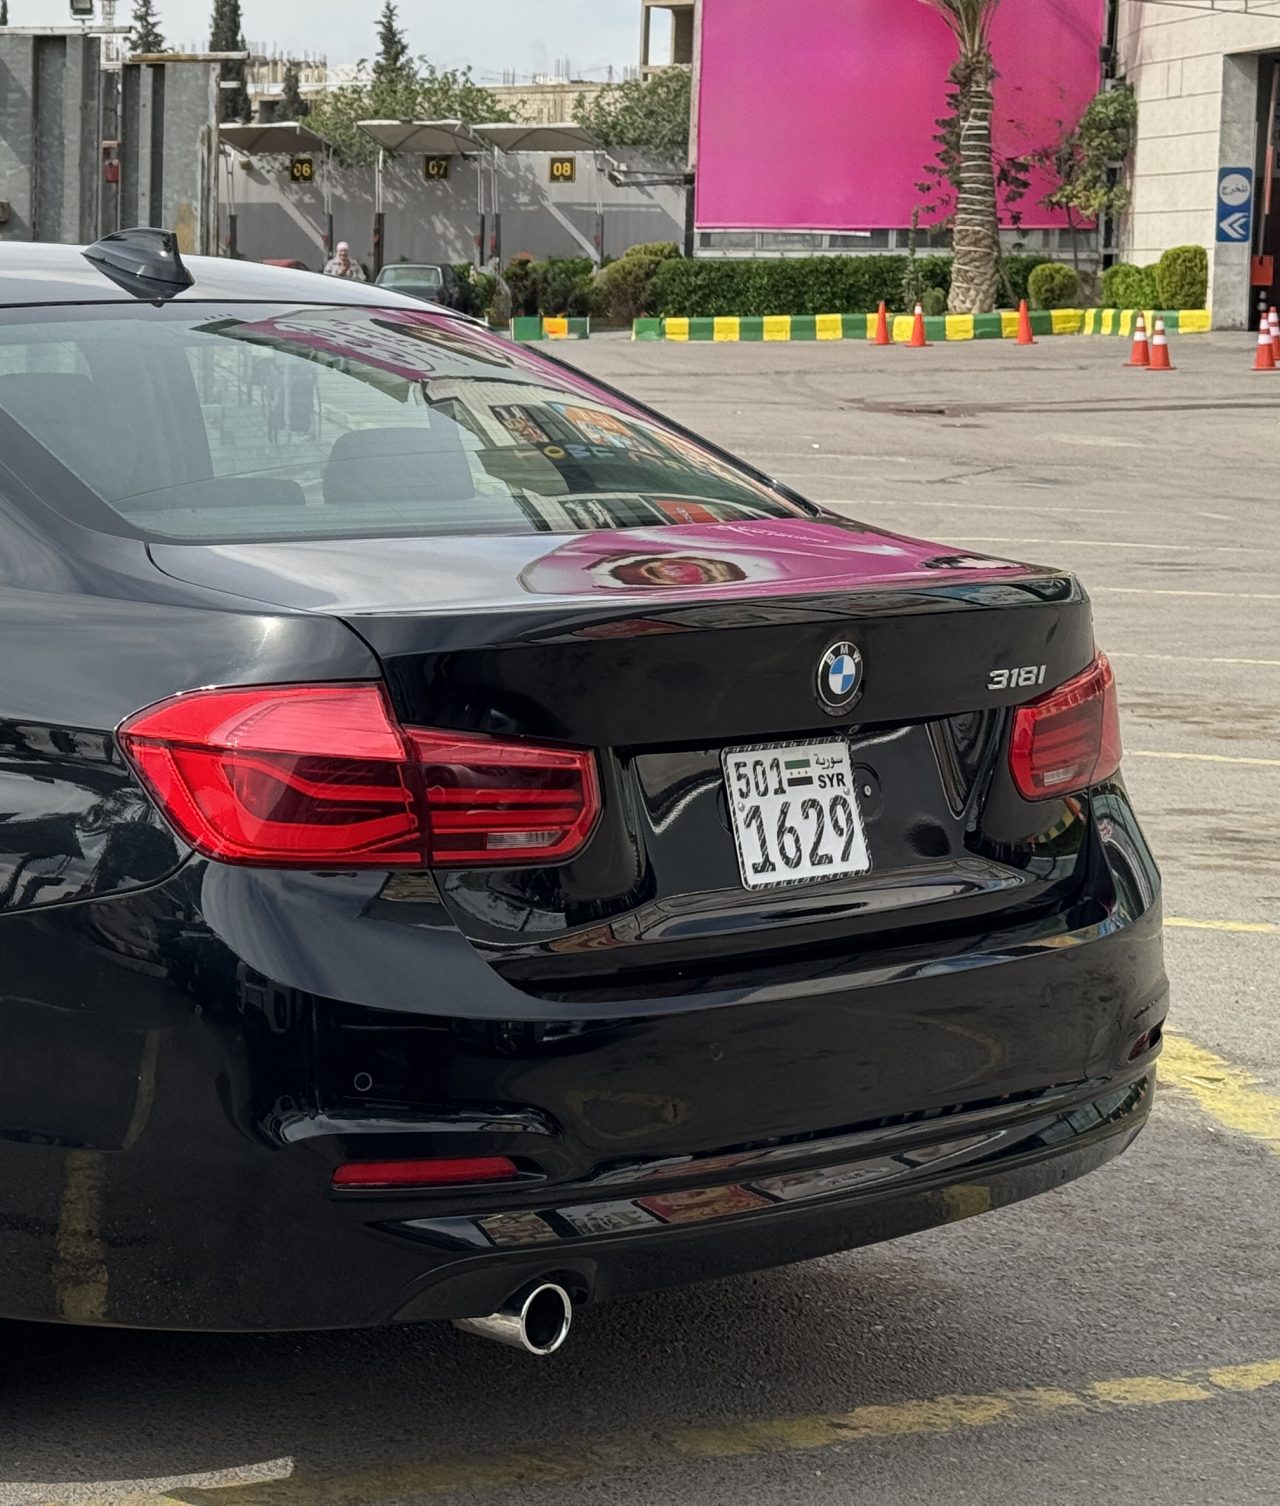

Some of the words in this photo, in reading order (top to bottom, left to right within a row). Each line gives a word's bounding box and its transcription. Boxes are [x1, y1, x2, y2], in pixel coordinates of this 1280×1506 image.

[293, 160, 311, 177] 06
[428, 160, 447, 175] 07
[552, 162, 571, 177] 08
[825, 643, 862, 666] BMW
[813, 752, 844, 770] سورية
[733, 756, 787, 799] 501
[817, 771, 847, 790] SYR
[742, 794, 856, 875] 1629
